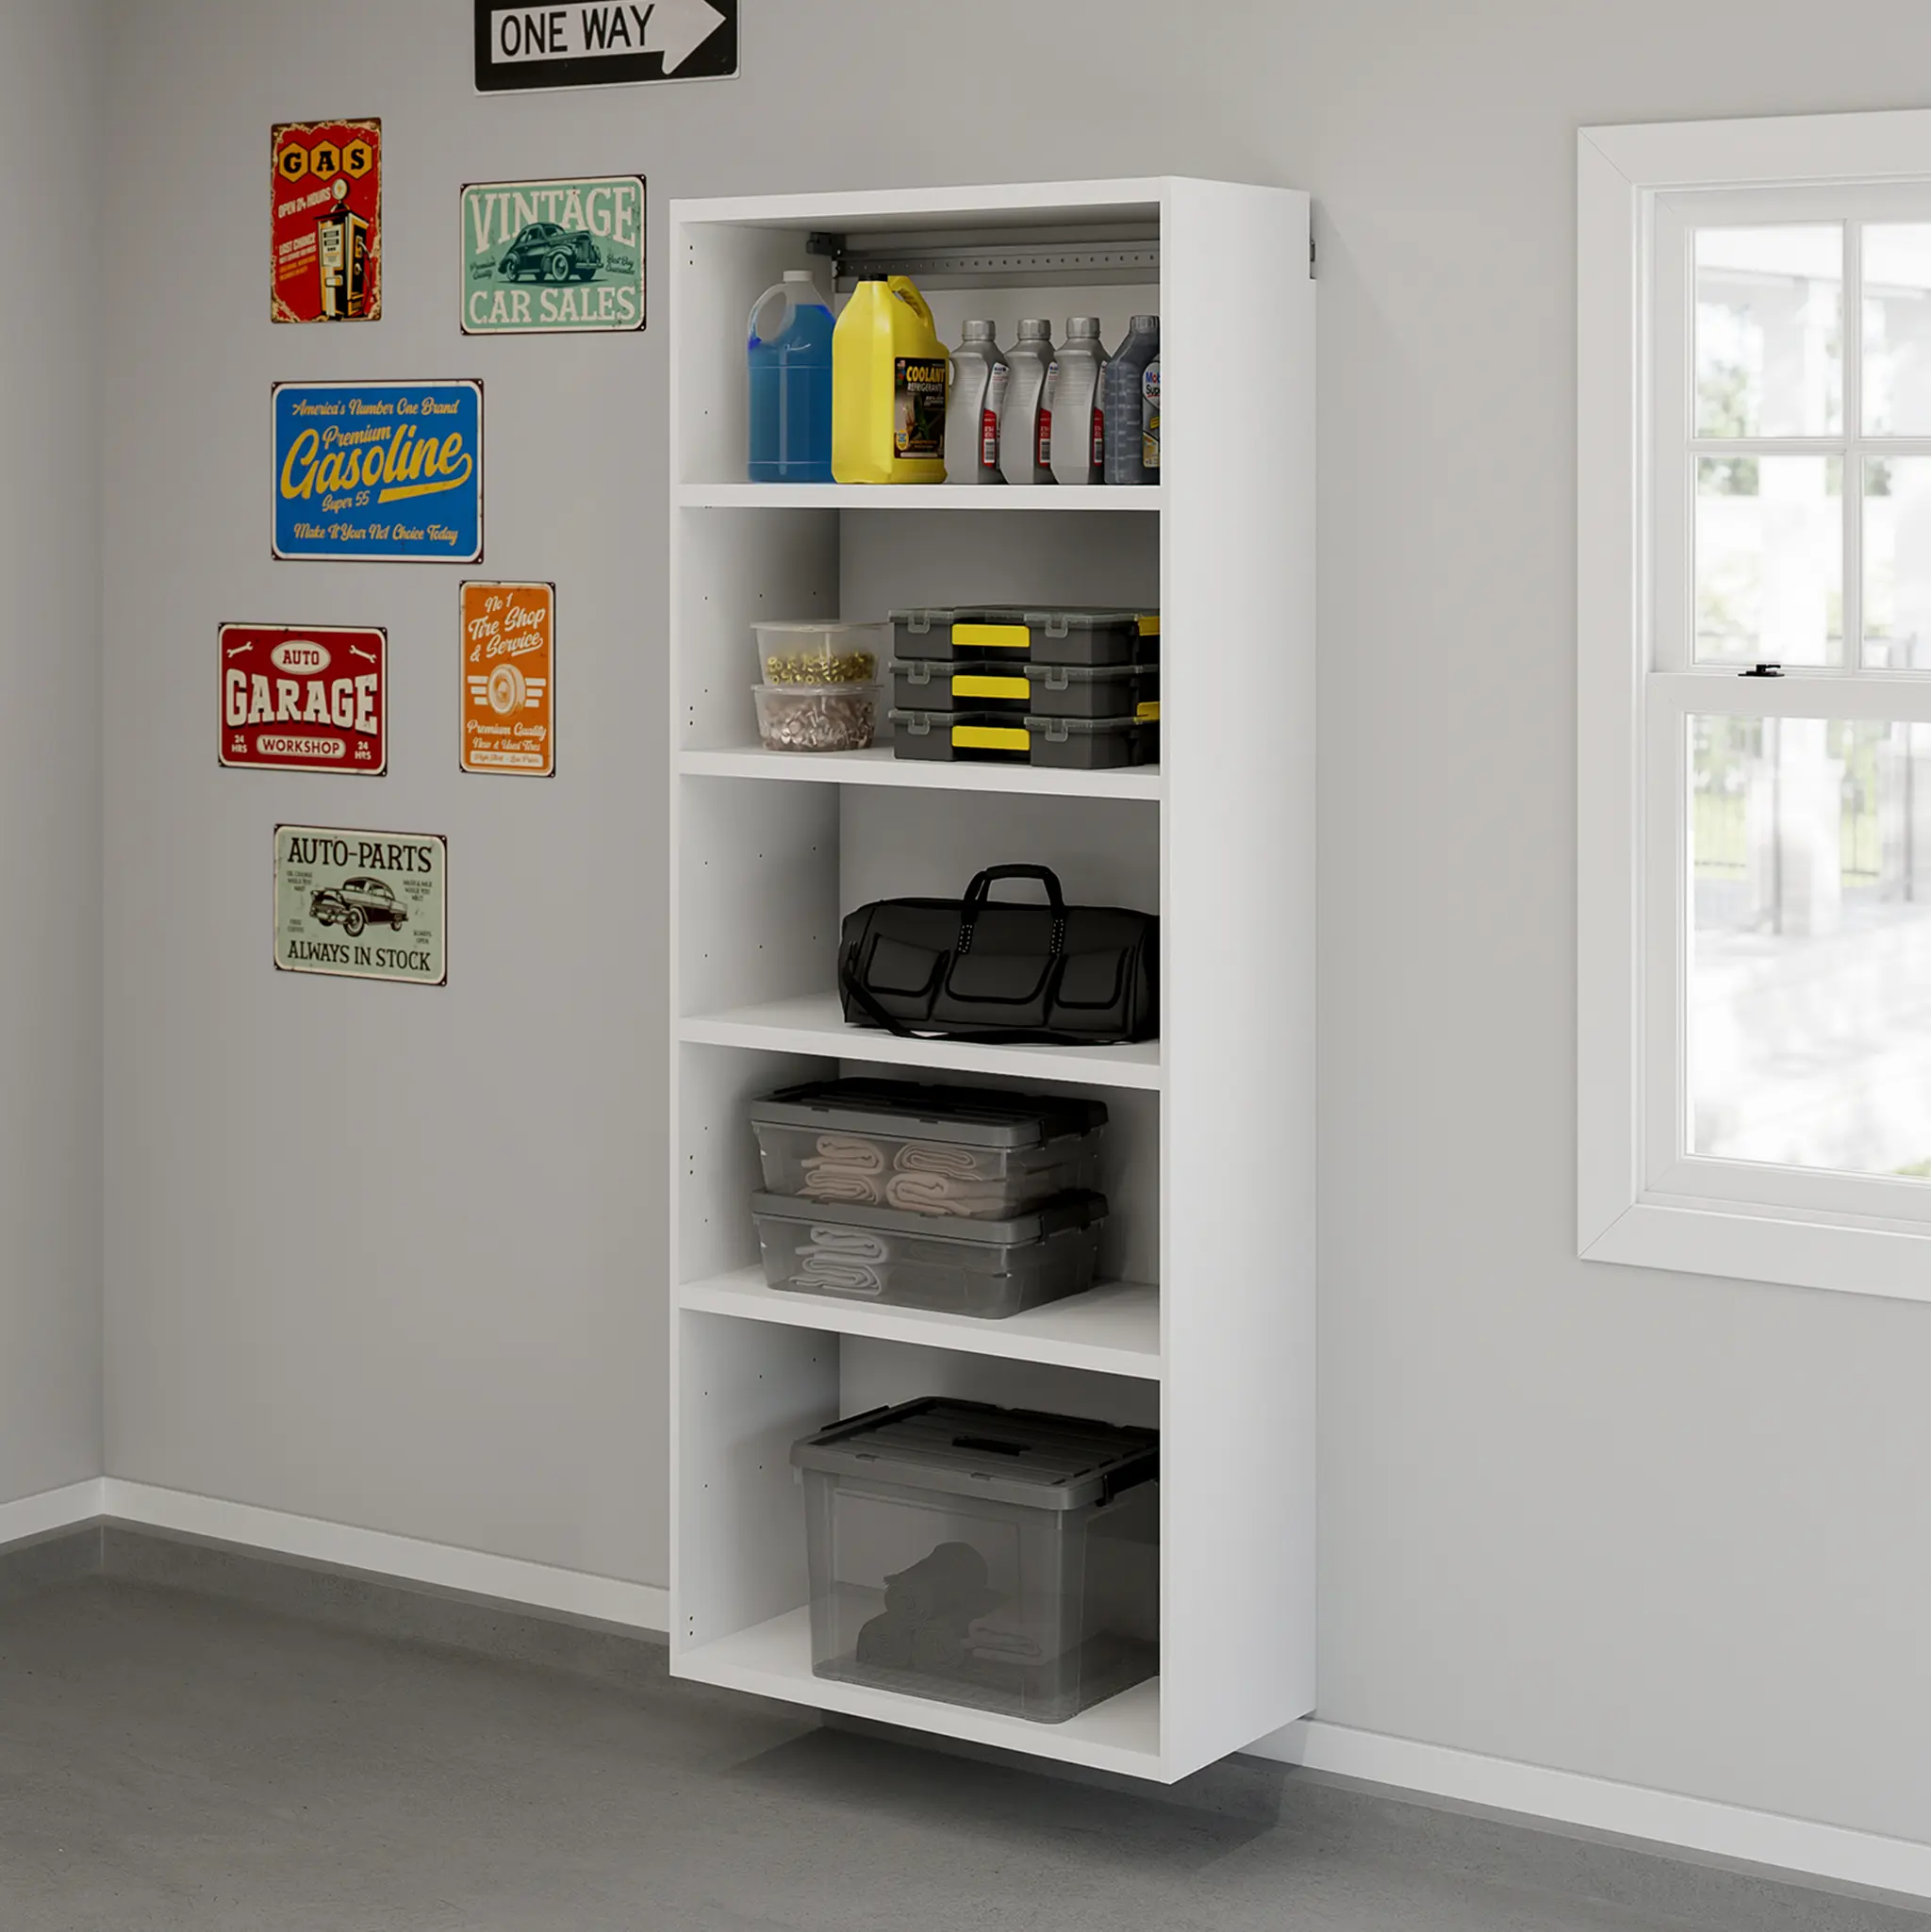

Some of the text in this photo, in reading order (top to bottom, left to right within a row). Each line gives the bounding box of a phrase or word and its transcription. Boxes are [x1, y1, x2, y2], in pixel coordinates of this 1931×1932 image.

[501, 4, 655, 57] ONE WAY
[284, 148, 365, 173] GAS
[278, 199, 296, 219] OPEN
[470, 187, 635, 255] VINTAGE
[470, 286, 635, 323] CAR SALES
[906, 366, 945, 382] COOLANT
[292, 396, 460, 416] America's Number One Brand
[322, 424, 391, 450] Premium
[280, 423, 472, 504] Gasoline
[322, 490, 371, 514] Super 55
[293, 522, 325, 539] Make
[340, 523, 367, 541] Your
[392, 523, 424, 540] Choice
[426, 524, 458, 546] Today
[485, 592, 514, 613] No 1
[468, 606, 546, 641] Tire Shop
[283, 650, 320, 666] AUTO
[470, 631, 544, 663] & Service
[226, 669, 377, 735] GARAGE
[467, 719, 511, 735] Premium
[231, 744, 248, 753] HRS
[234, 735, 245, 744] 24
[262, 738, 339, 754] WORKSHOP
[357, 741, 369, 751] 24
[355, 751, 371, 760] HRS
[288, 836, 432, 873] AUTO-PARTS
[288, 941, 431, 971] ALWAYS IN STOCK
